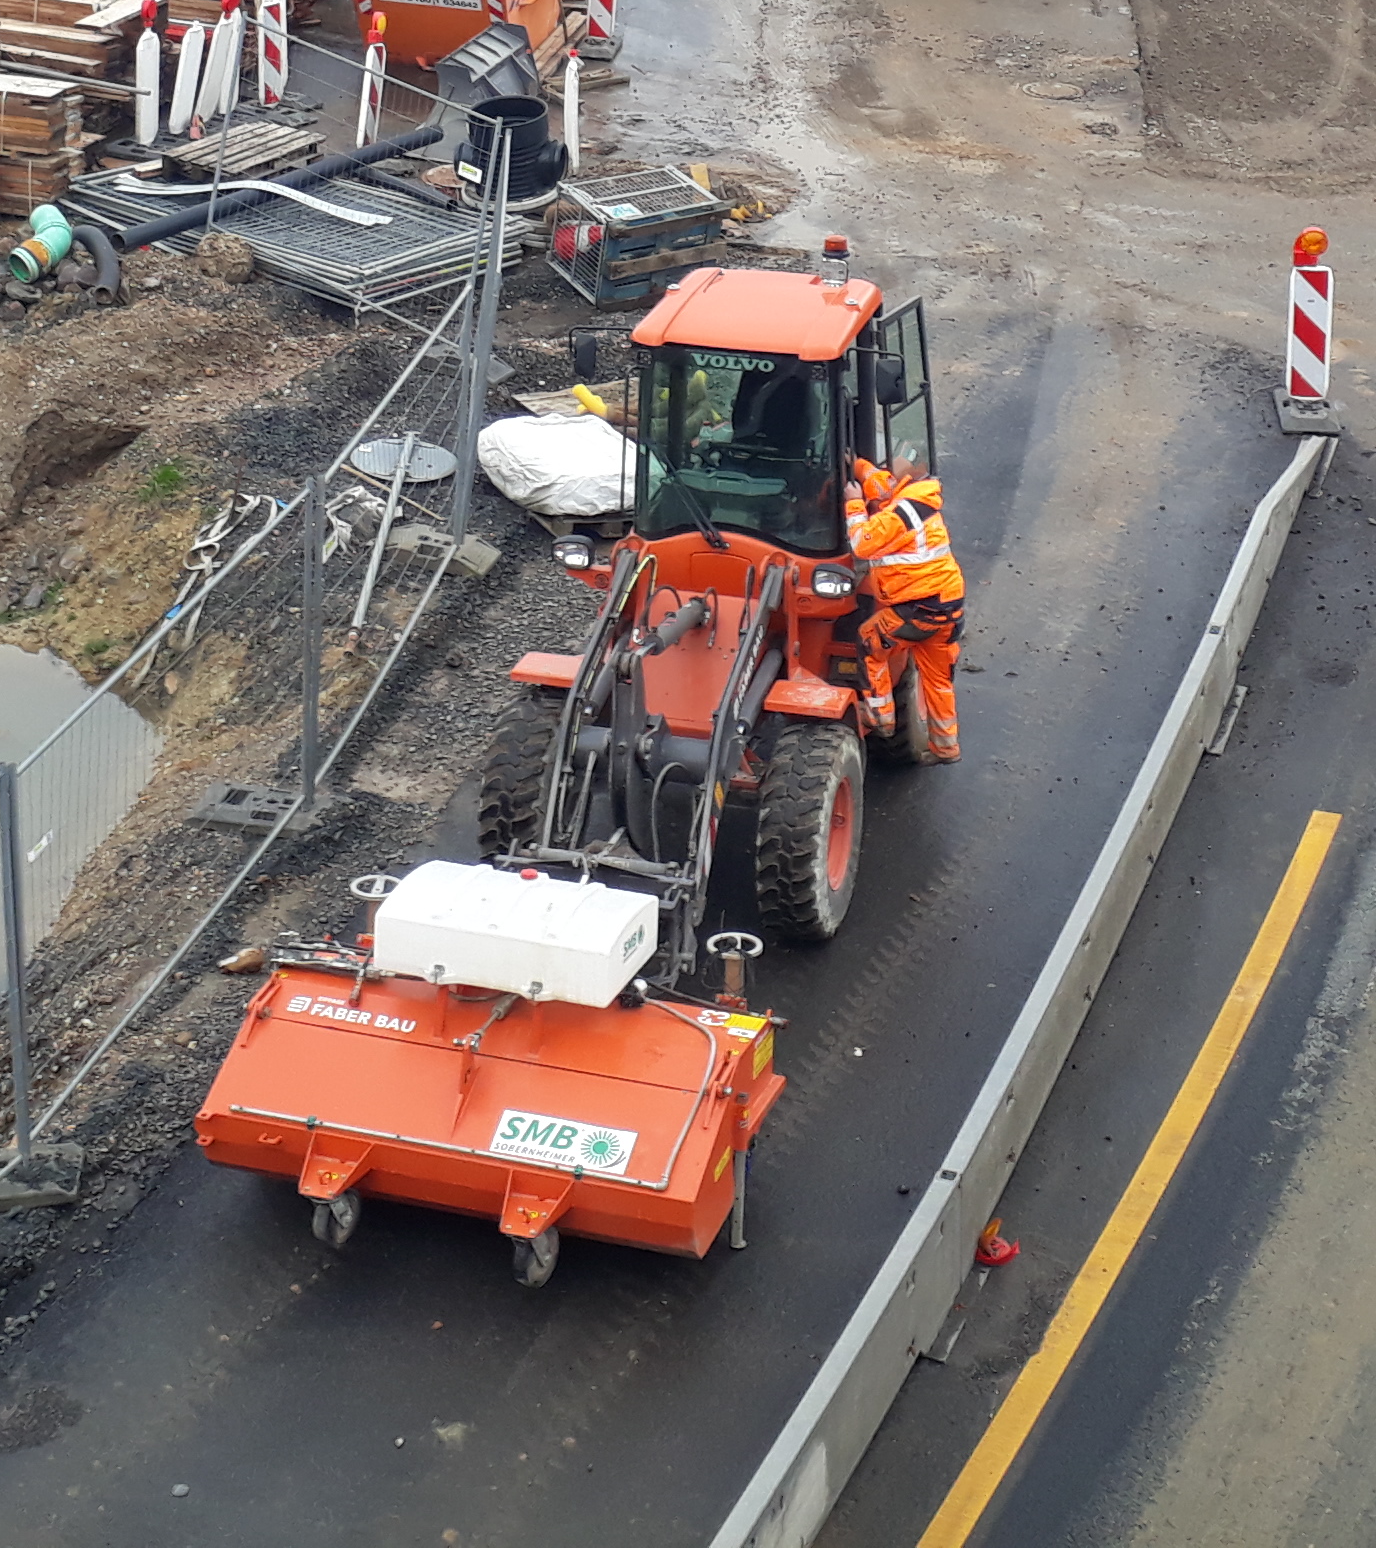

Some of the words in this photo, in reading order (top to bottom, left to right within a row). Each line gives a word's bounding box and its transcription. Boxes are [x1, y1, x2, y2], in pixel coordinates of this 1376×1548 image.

[690, 352, 775, 373] VOLVO
[310, 1003, 372, 1025] FABER
[374, 1014, 417, 1033] BAU
[499, 1116, 579, 1149] SMB
[493, 1142, 576, 1163] SOBERNHEIMER
